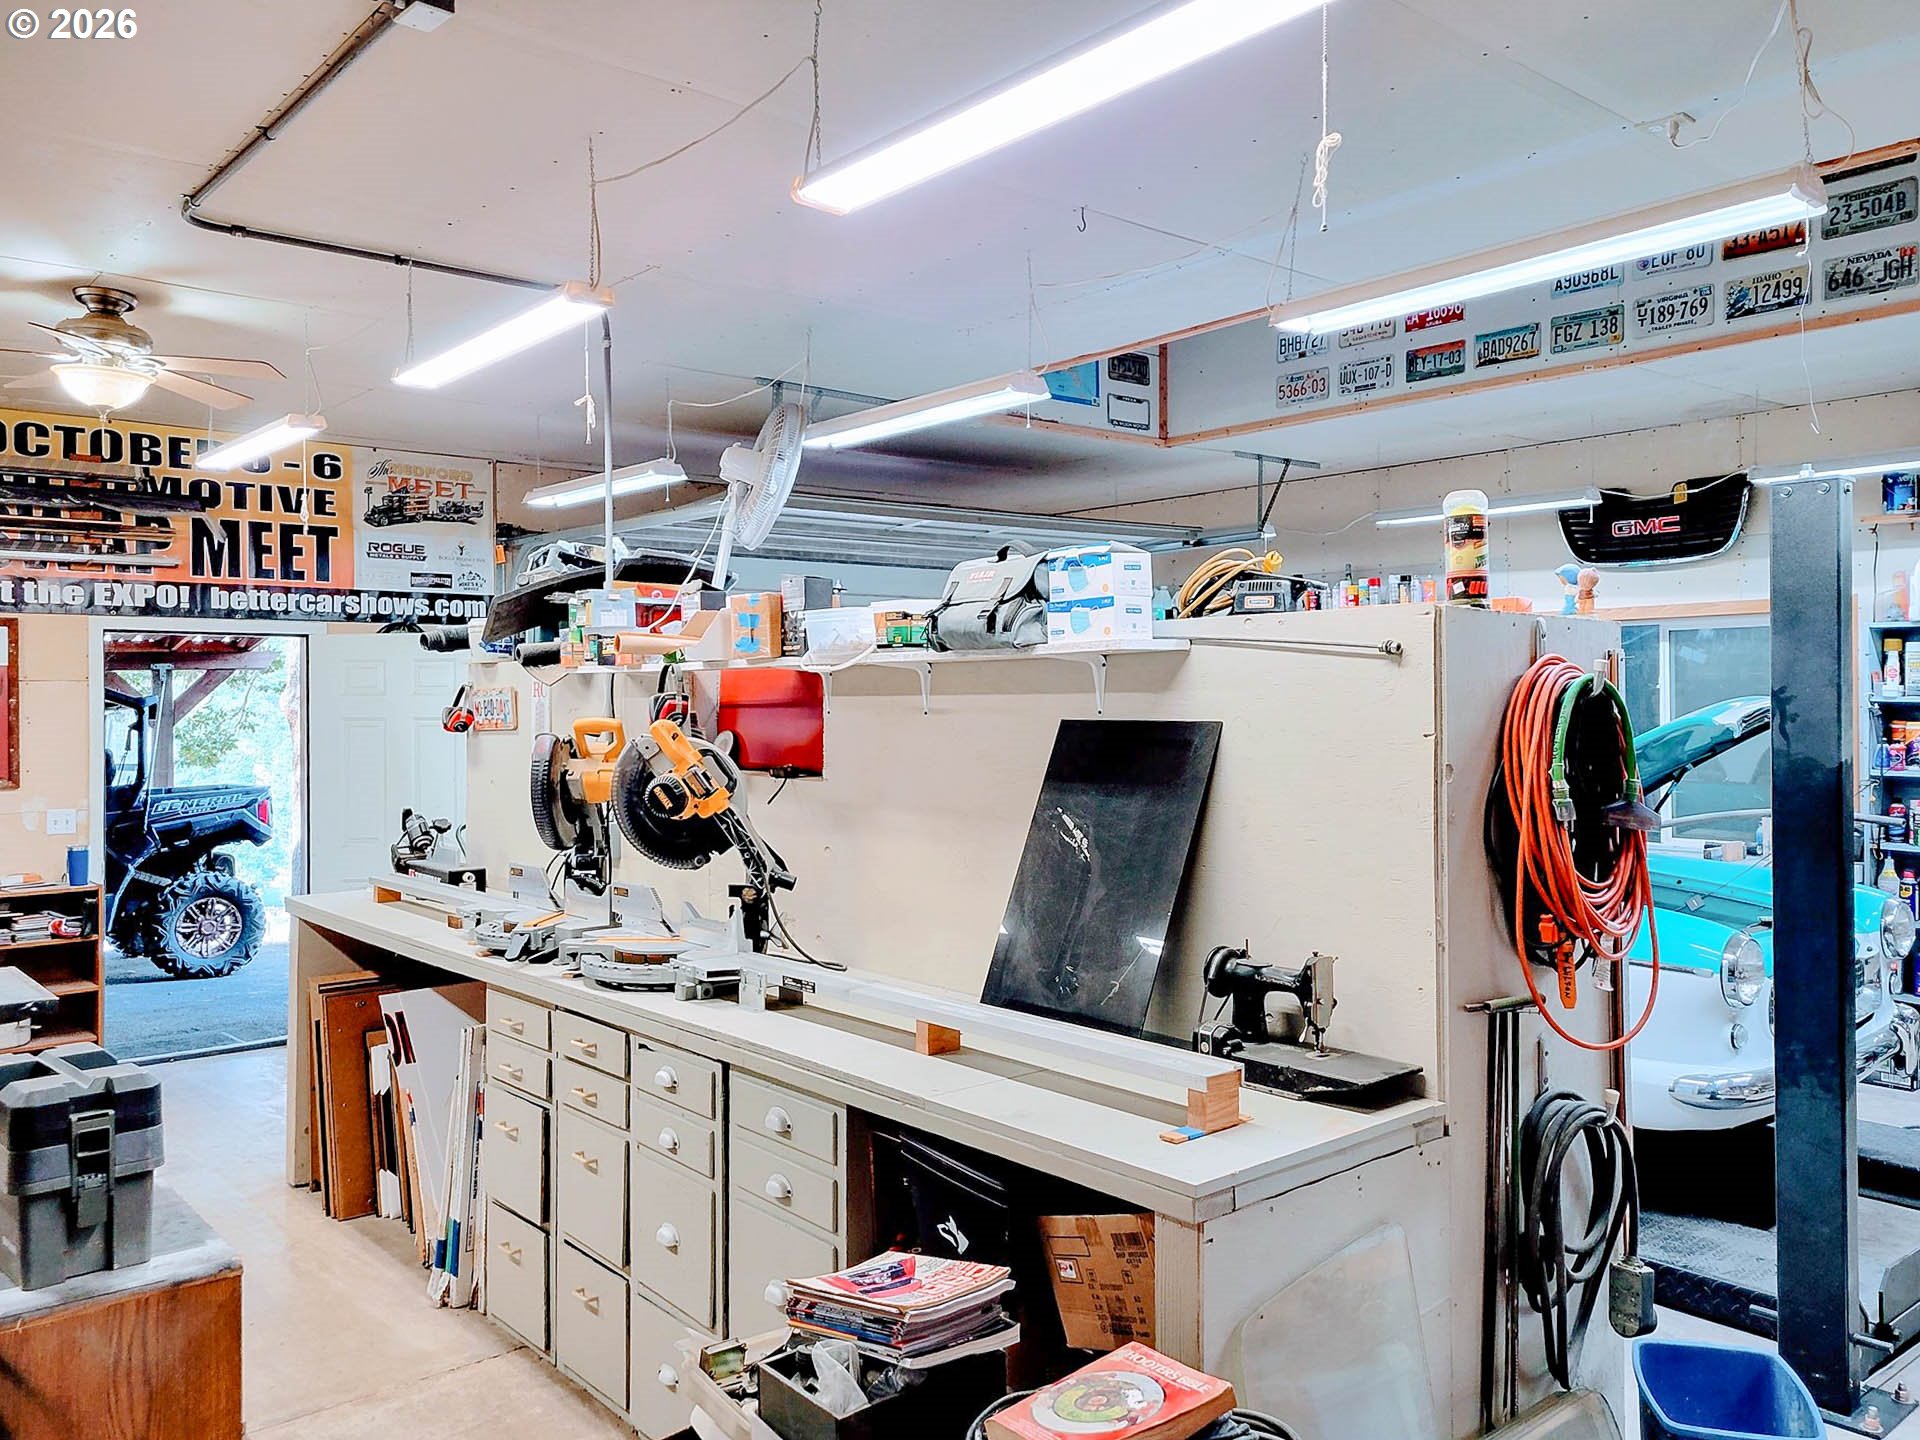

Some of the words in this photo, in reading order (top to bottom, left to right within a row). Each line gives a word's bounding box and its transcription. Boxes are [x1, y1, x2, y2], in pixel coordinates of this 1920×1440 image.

[1829, 191, 1907, 227] 23-504B
[1847, 250, 1892, 266] NEVADA
[1752, 272, 1782, 284] IDAHO
[1828, 254, 1913, 292] 646-JGH
[1657, 292, 1689, 304] VIRGINIA
[1753, 277, 1803, 306] 12499
[1649, 297, 1708, 325] 189-769
[1554, 322, 1582, 345] FGZ
[1590, 316, 1618, 339] 138
[1483, 331, 1537, 359] BAD9267
[0, 419, 224, 469] CTOBE
[312, 453, 342, 480] 6
[387, 476, 474, 500] MEET
[1612, 516, 1680, 537] GMC
[190, 517, 339, 583] MEET
[368, 542, 425, 554] ROGUE
[24, 577, 85, 606] the
[94, 583, 190, 609] EXPO!
[210, 586, 487, 618] bettercarshows.com
